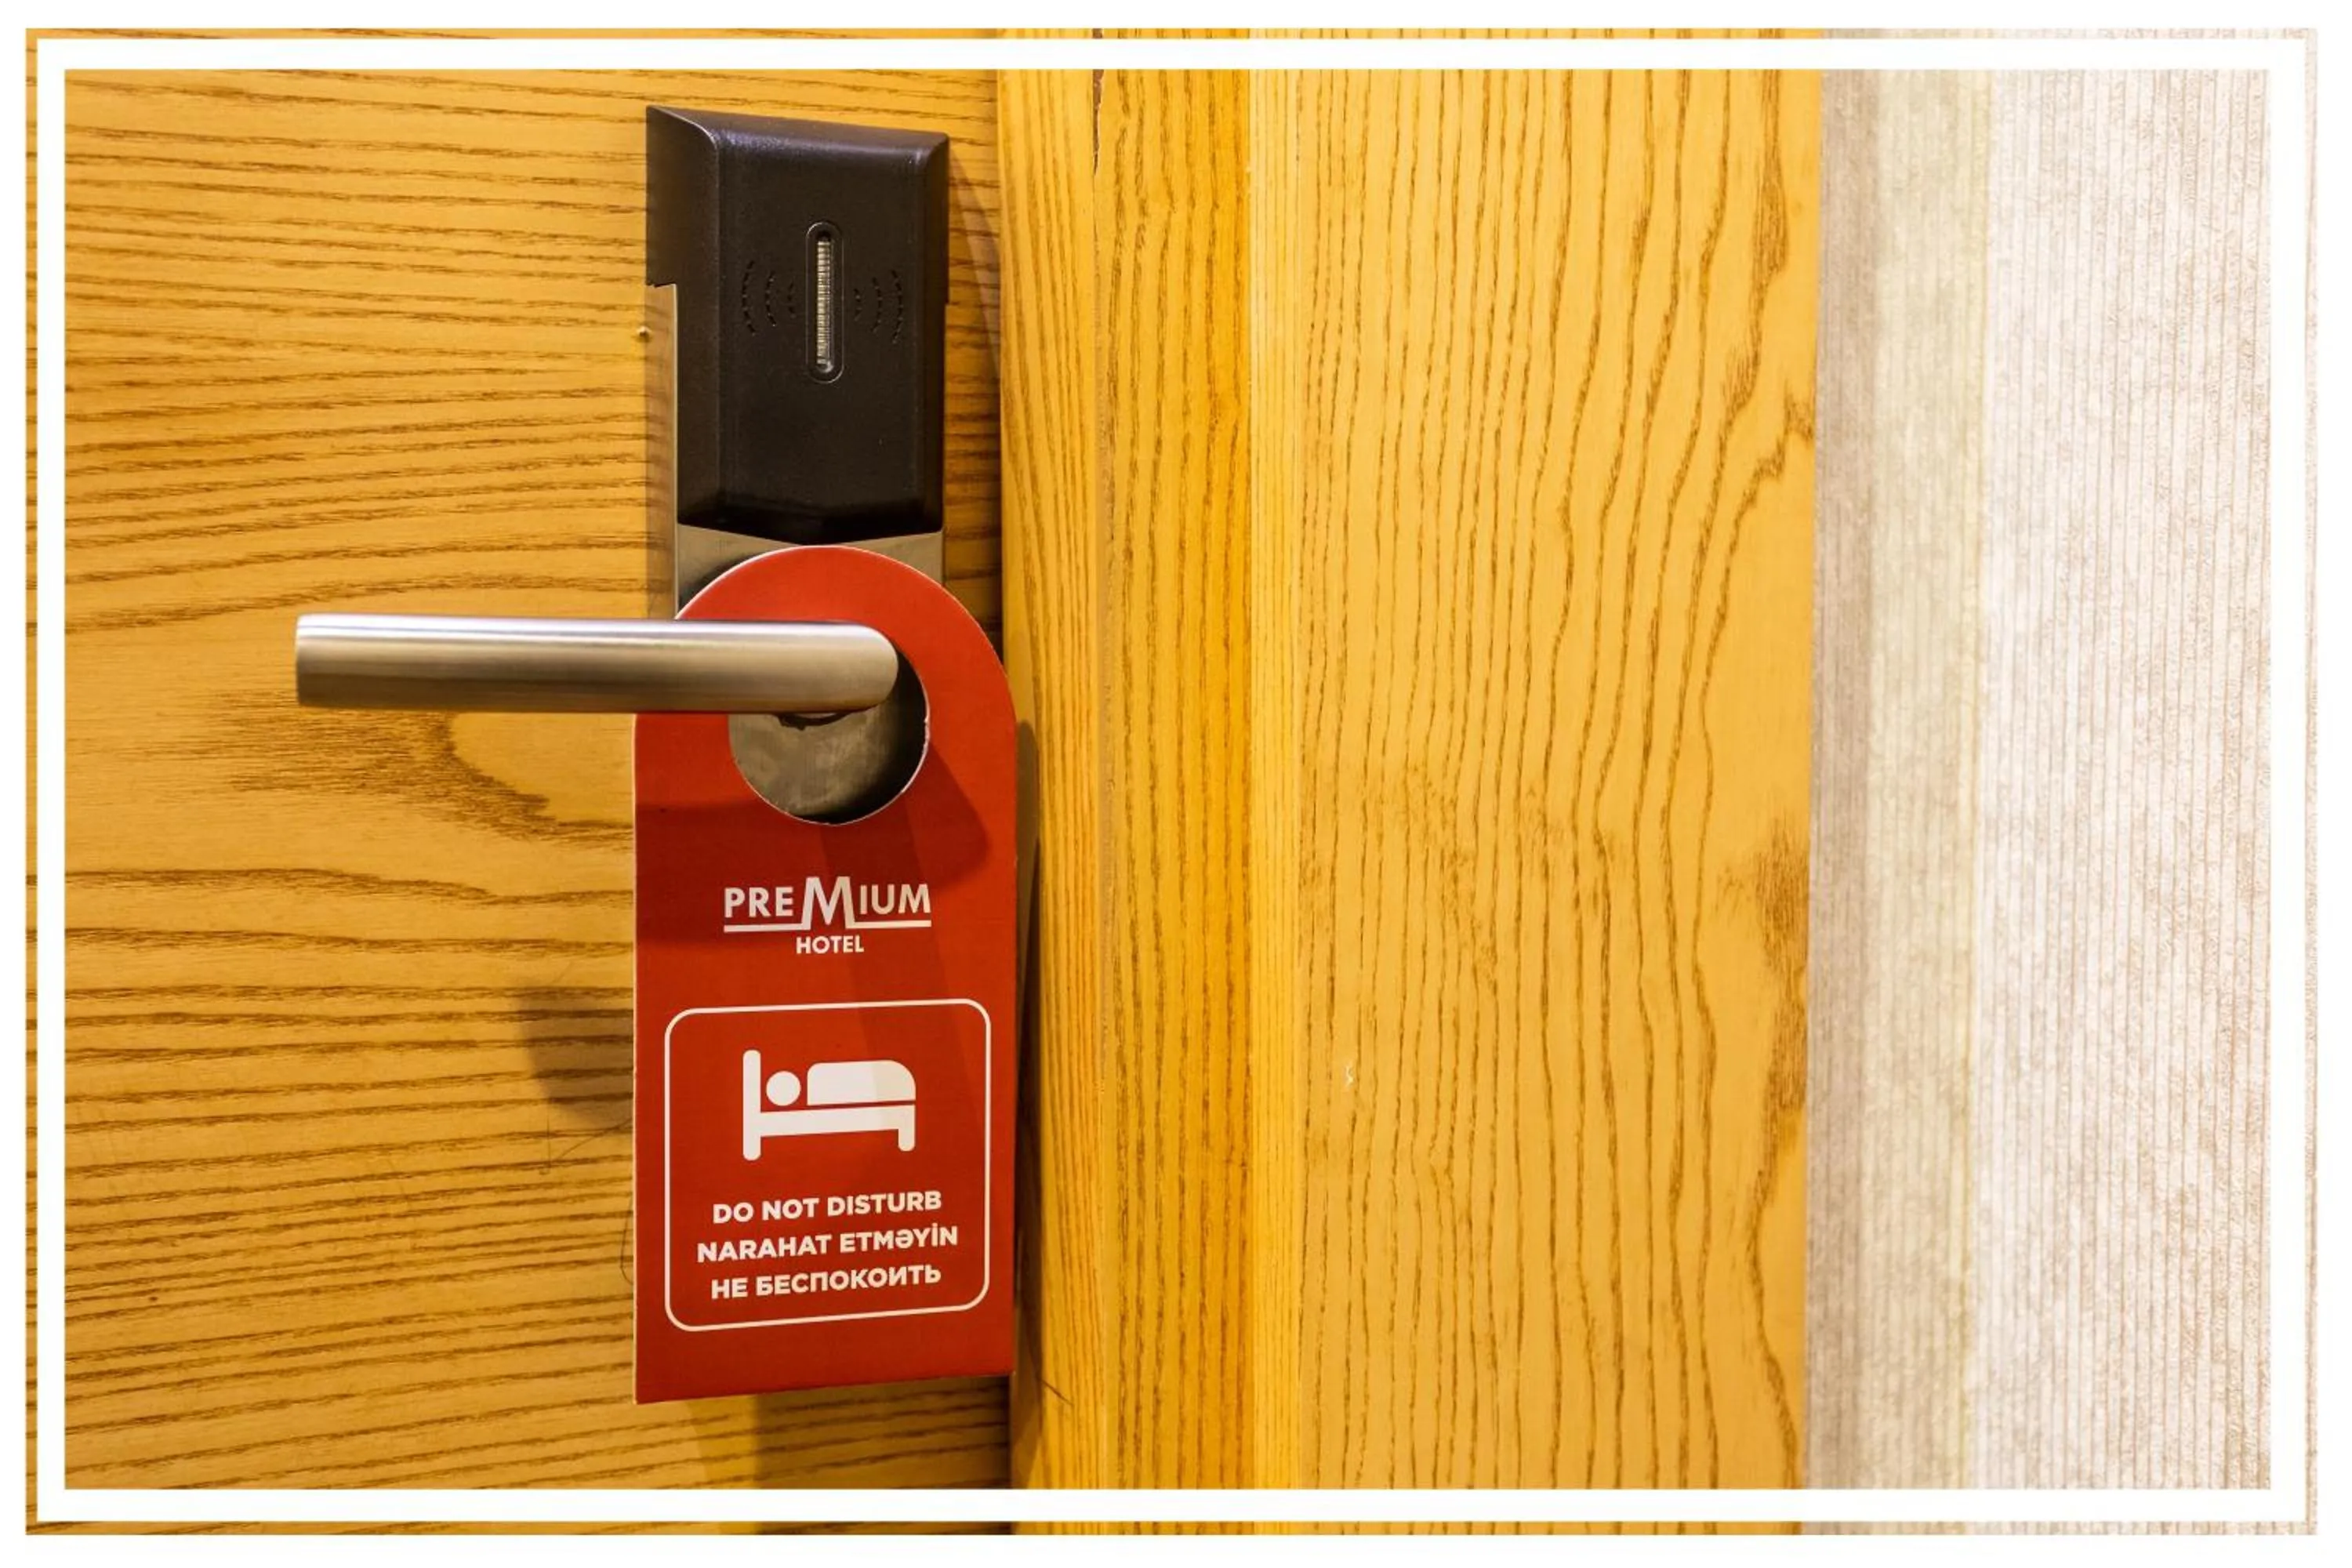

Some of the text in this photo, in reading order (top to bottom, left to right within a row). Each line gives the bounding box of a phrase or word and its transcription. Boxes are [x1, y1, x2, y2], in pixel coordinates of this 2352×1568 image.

[724, 876, 931, 931] PREMIUM
[796, 935, 865, 954] HOTEL
[713, 1190, 942, 1224] DO NOT DISTURB
[697, 1235, 832, 1263] NARAHAT
[710, 1264, 942, 1299] НЕ БЕСПОКОИТЬ
